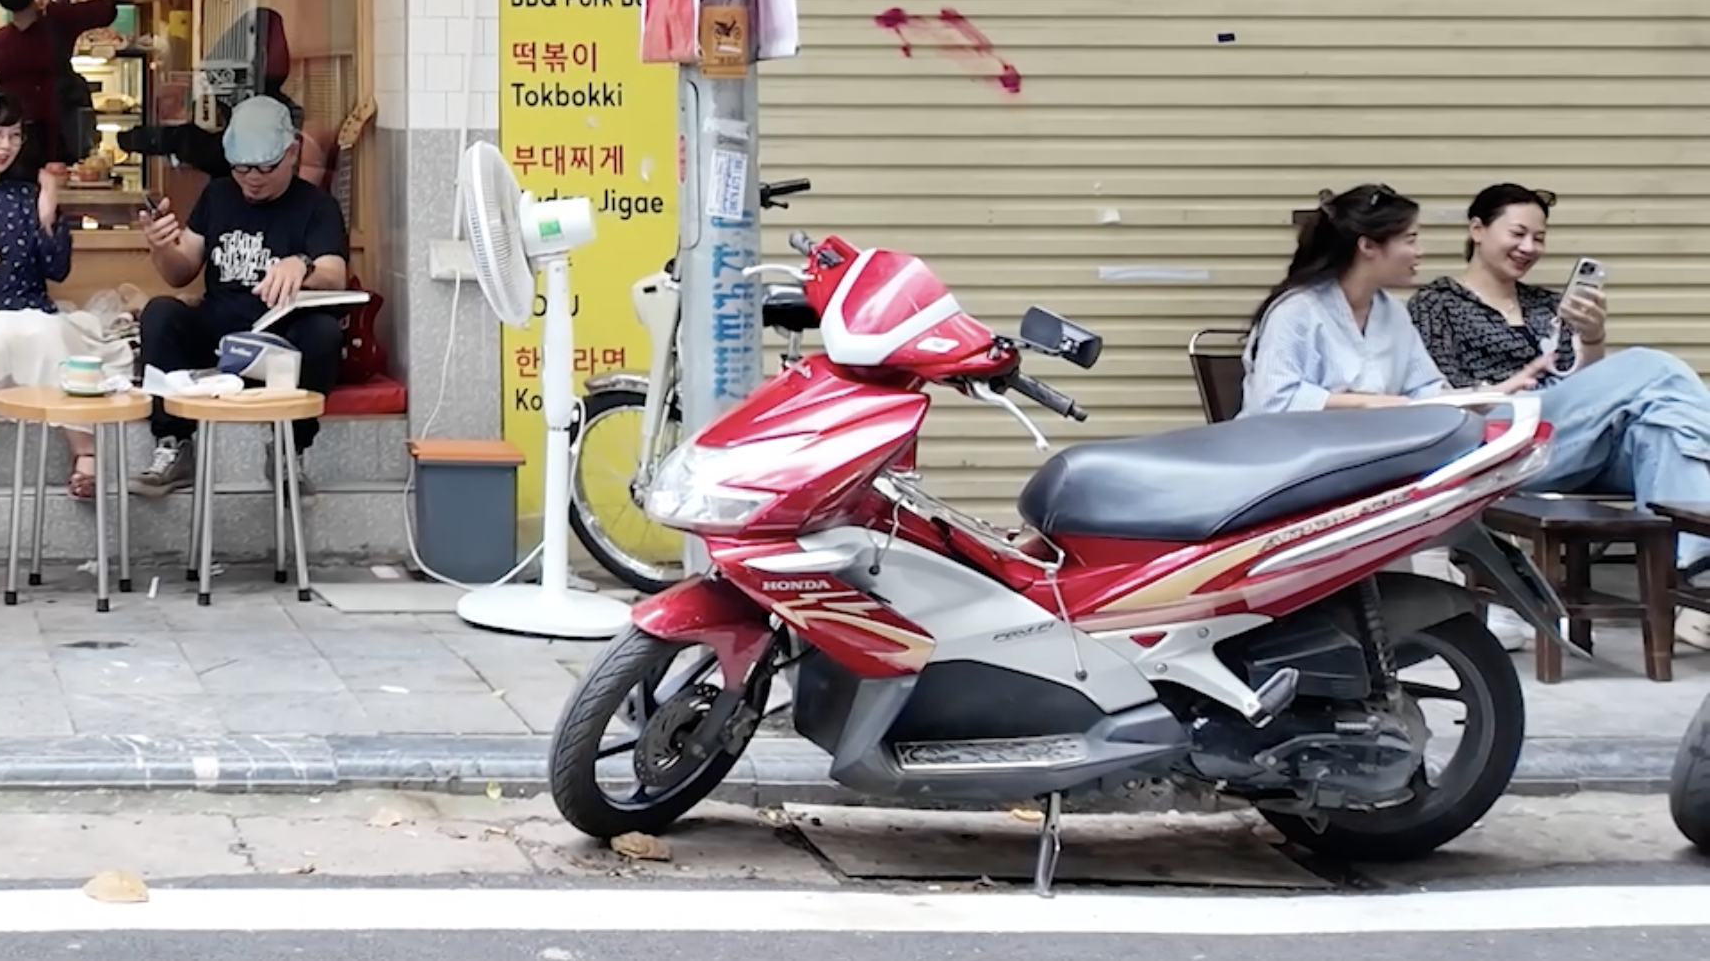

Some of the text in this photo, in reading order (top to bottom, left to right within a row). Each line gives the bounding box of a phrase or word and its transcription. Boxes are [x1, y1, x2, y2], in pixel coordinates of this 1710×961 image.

[512, 42, 598, 73] 떡볶이
[511, 82, 623, 107] Tokbokki
[512, 145, 624, 176] 부대찌게
[598, 189, 664, 220] Jigae
[515, 346, 626, 378] 한라면
[762, 580, 831, 590] HONDA
